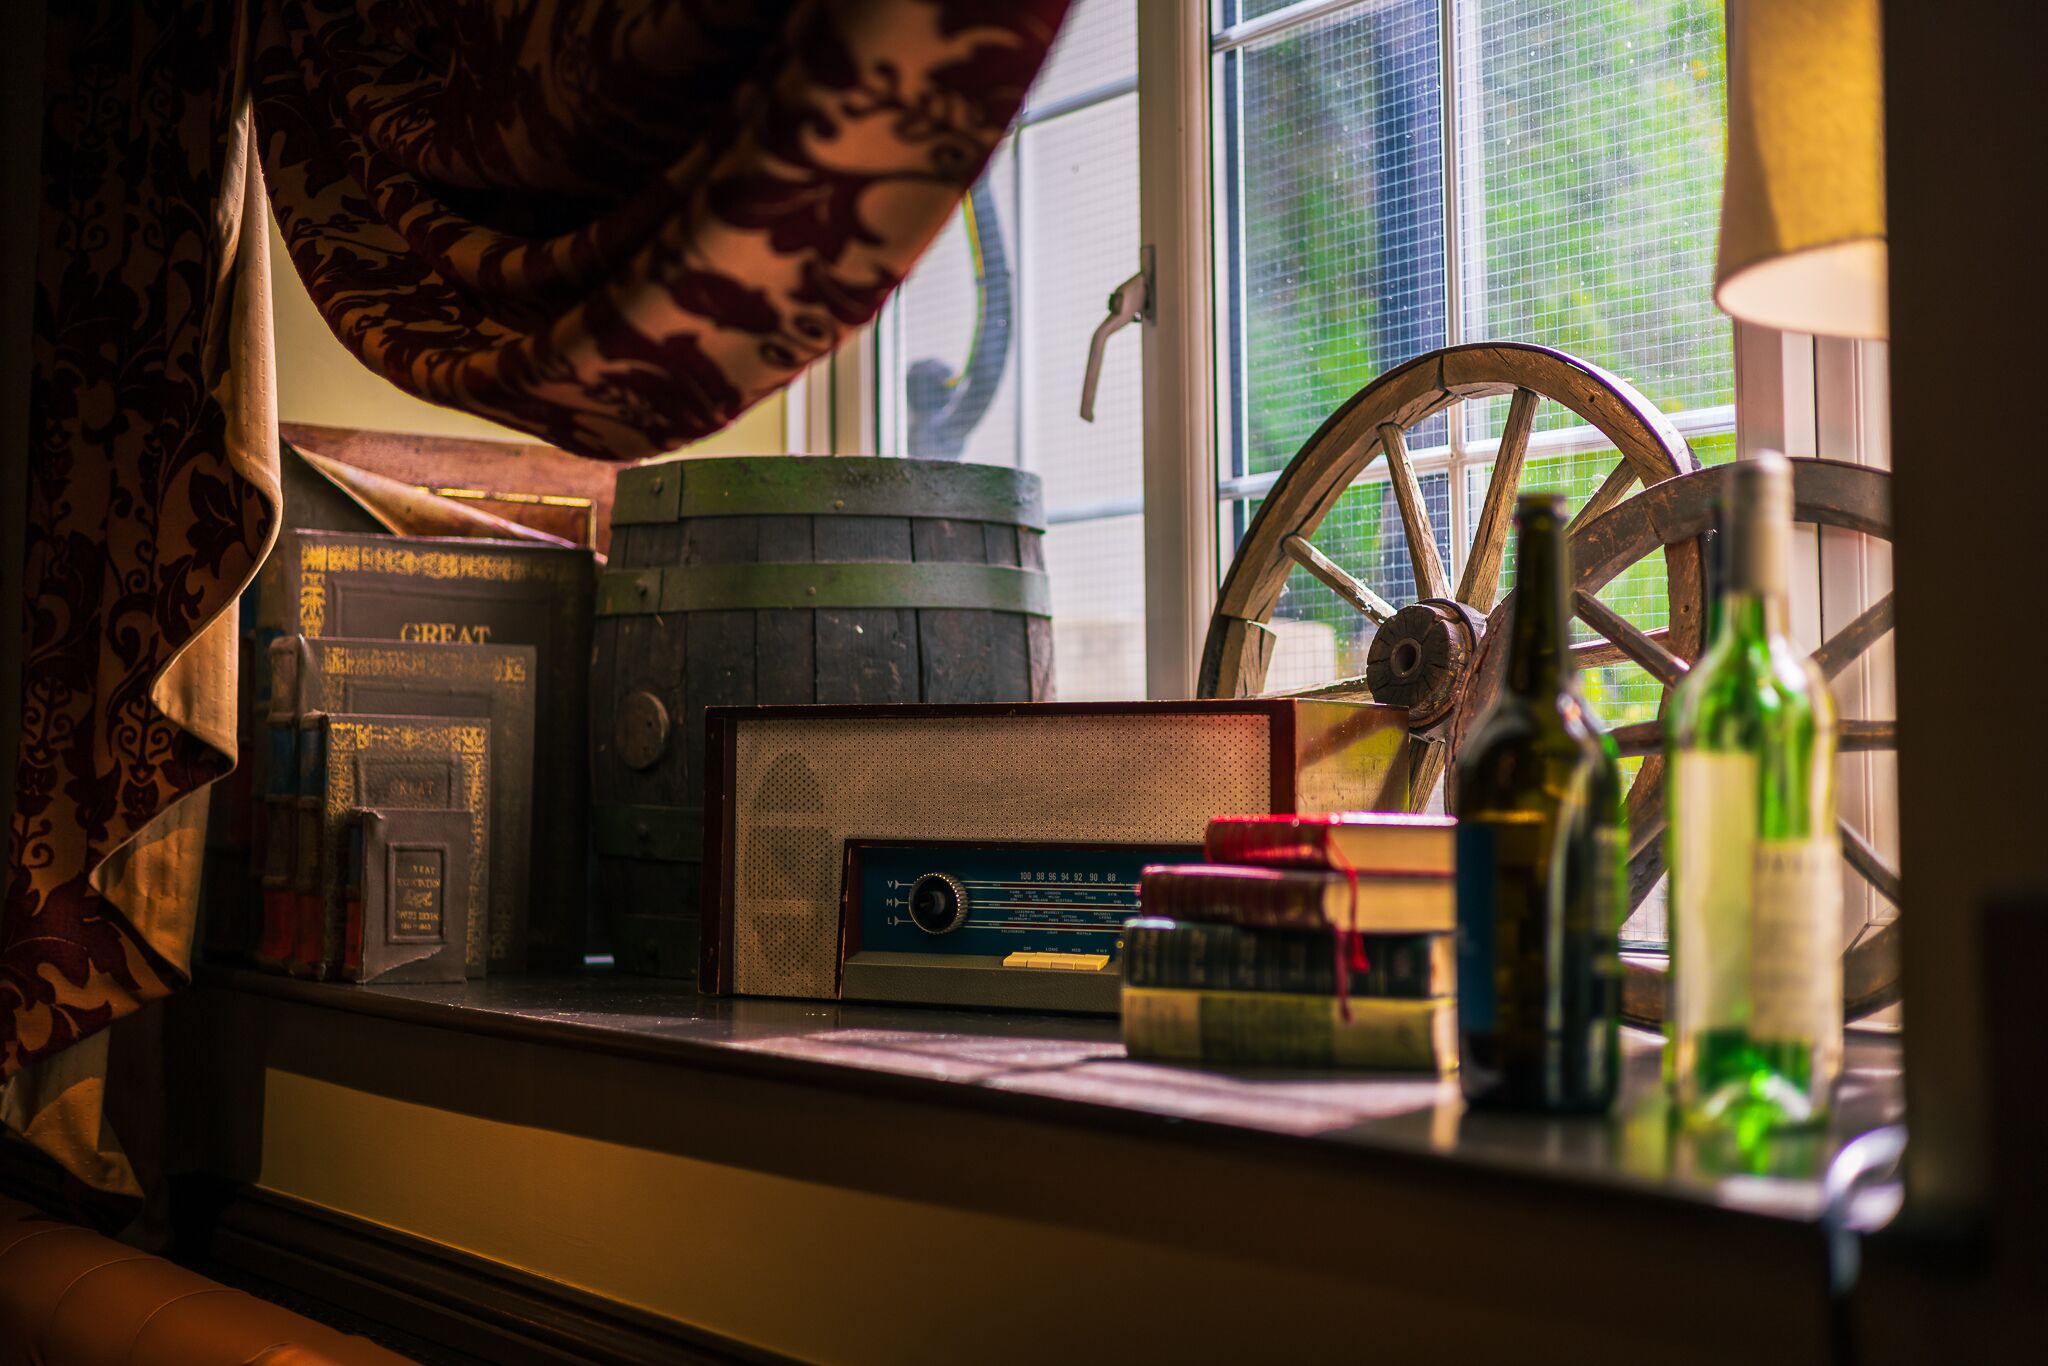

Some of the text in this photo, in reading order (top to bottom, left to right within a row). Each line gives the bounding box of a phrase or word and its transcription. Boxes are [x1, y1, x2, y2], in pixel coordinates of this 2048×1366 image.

[400, 622, 492, 644] GREAT
[1020, 872, 1116, 881] 100 98 96 94 92 90 88
